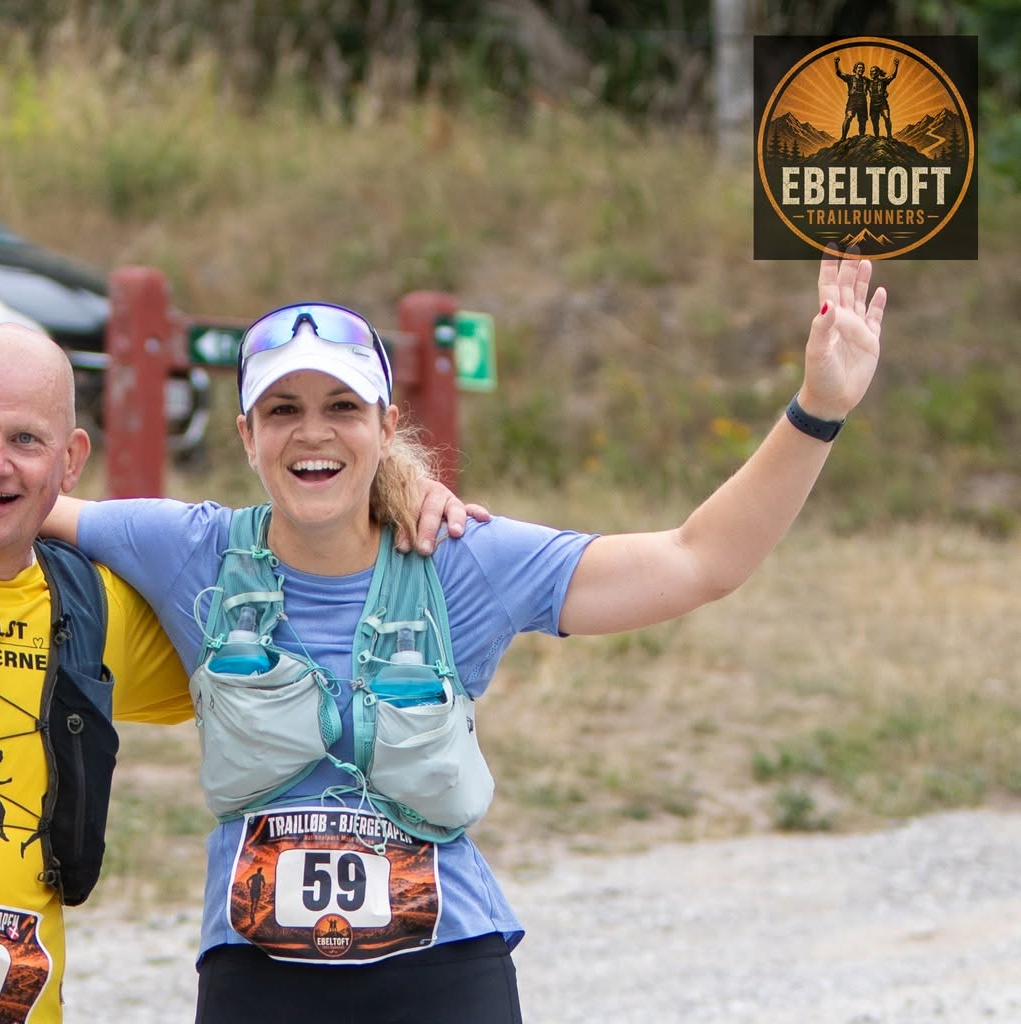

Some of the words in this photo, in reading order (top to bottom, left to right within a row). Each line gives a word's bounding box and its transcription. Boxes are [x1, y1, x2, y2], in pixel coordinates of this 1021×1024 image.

[267, 813, 327, 838] TRAILLØB
[302, 852, 366, 911] 59
[317, 937, 349, 946] EBELTOFT
